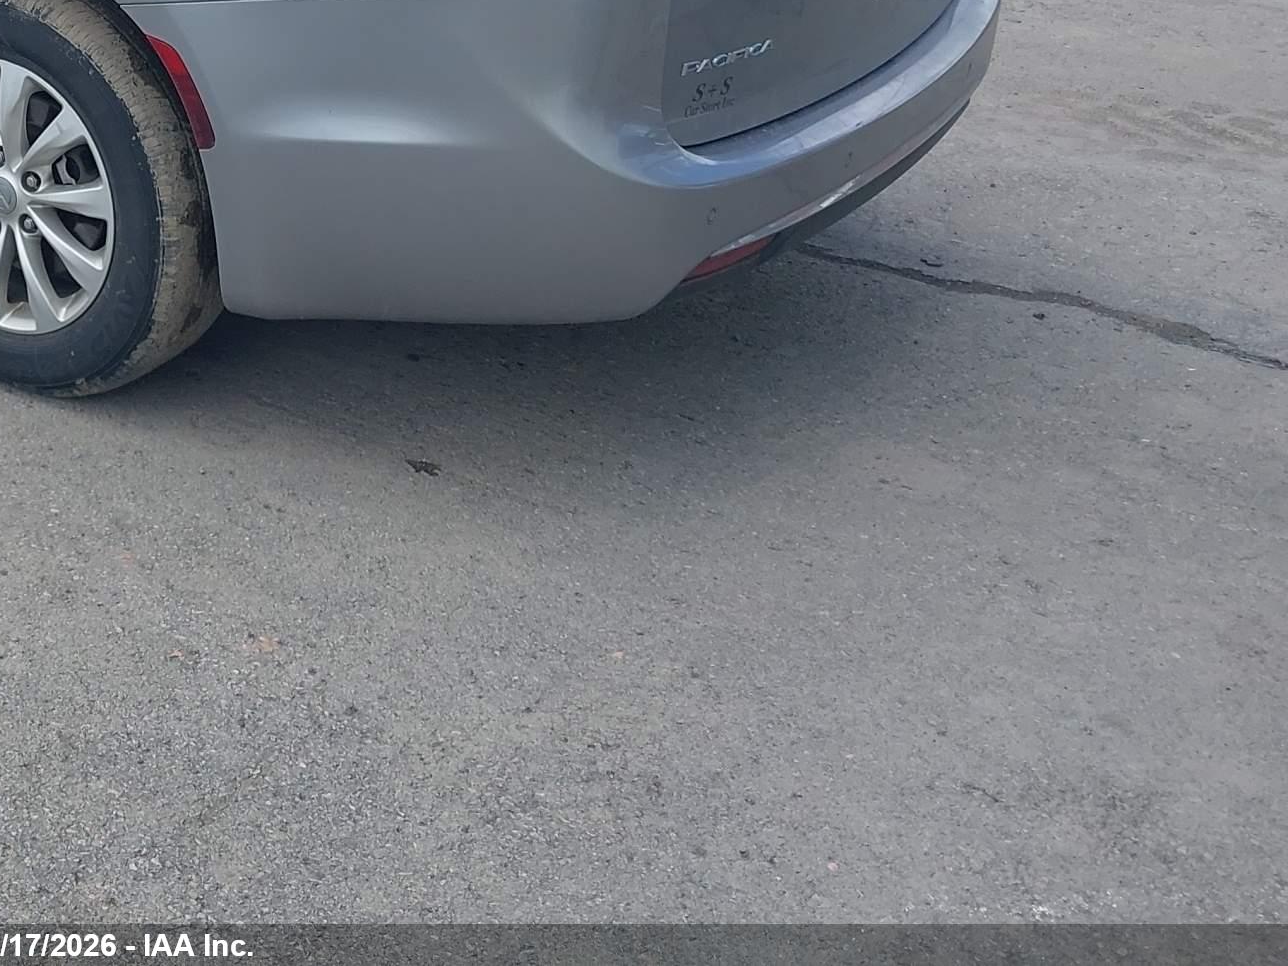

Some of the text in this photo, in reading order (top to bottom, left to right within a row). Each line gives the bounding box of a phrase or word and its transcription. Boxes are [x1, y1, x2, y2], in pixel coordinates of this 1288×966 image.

[681, 38, 772, 76] PACIFICA
[692, 82, 706, 102] S
[720, 76, 733, 95] S
